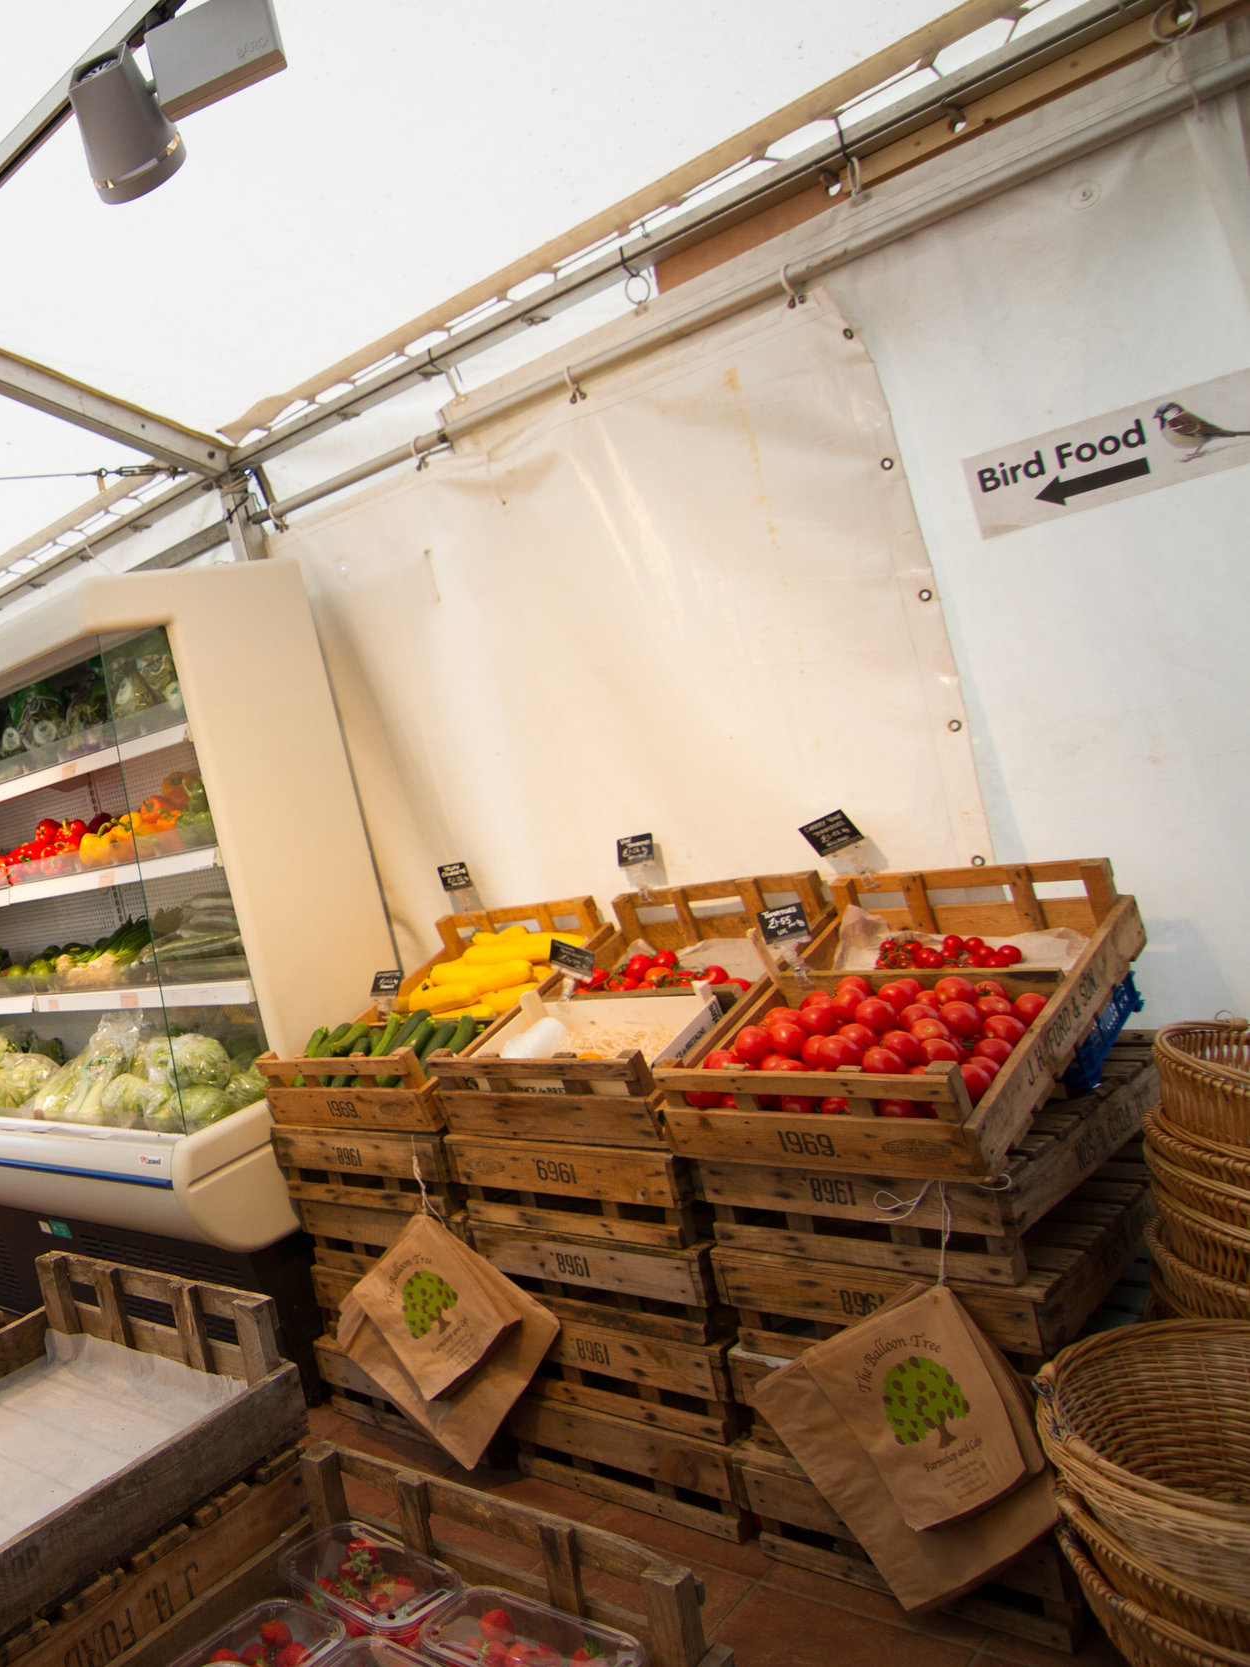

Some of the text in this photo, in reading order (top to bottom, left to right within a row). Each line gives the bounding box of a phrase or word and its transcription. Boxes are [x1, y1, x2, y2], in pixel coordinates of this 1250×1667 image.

[977, 418, 1147, 493] Bird Food
[854, 1333, 941, 1393] The Balloon Tree
